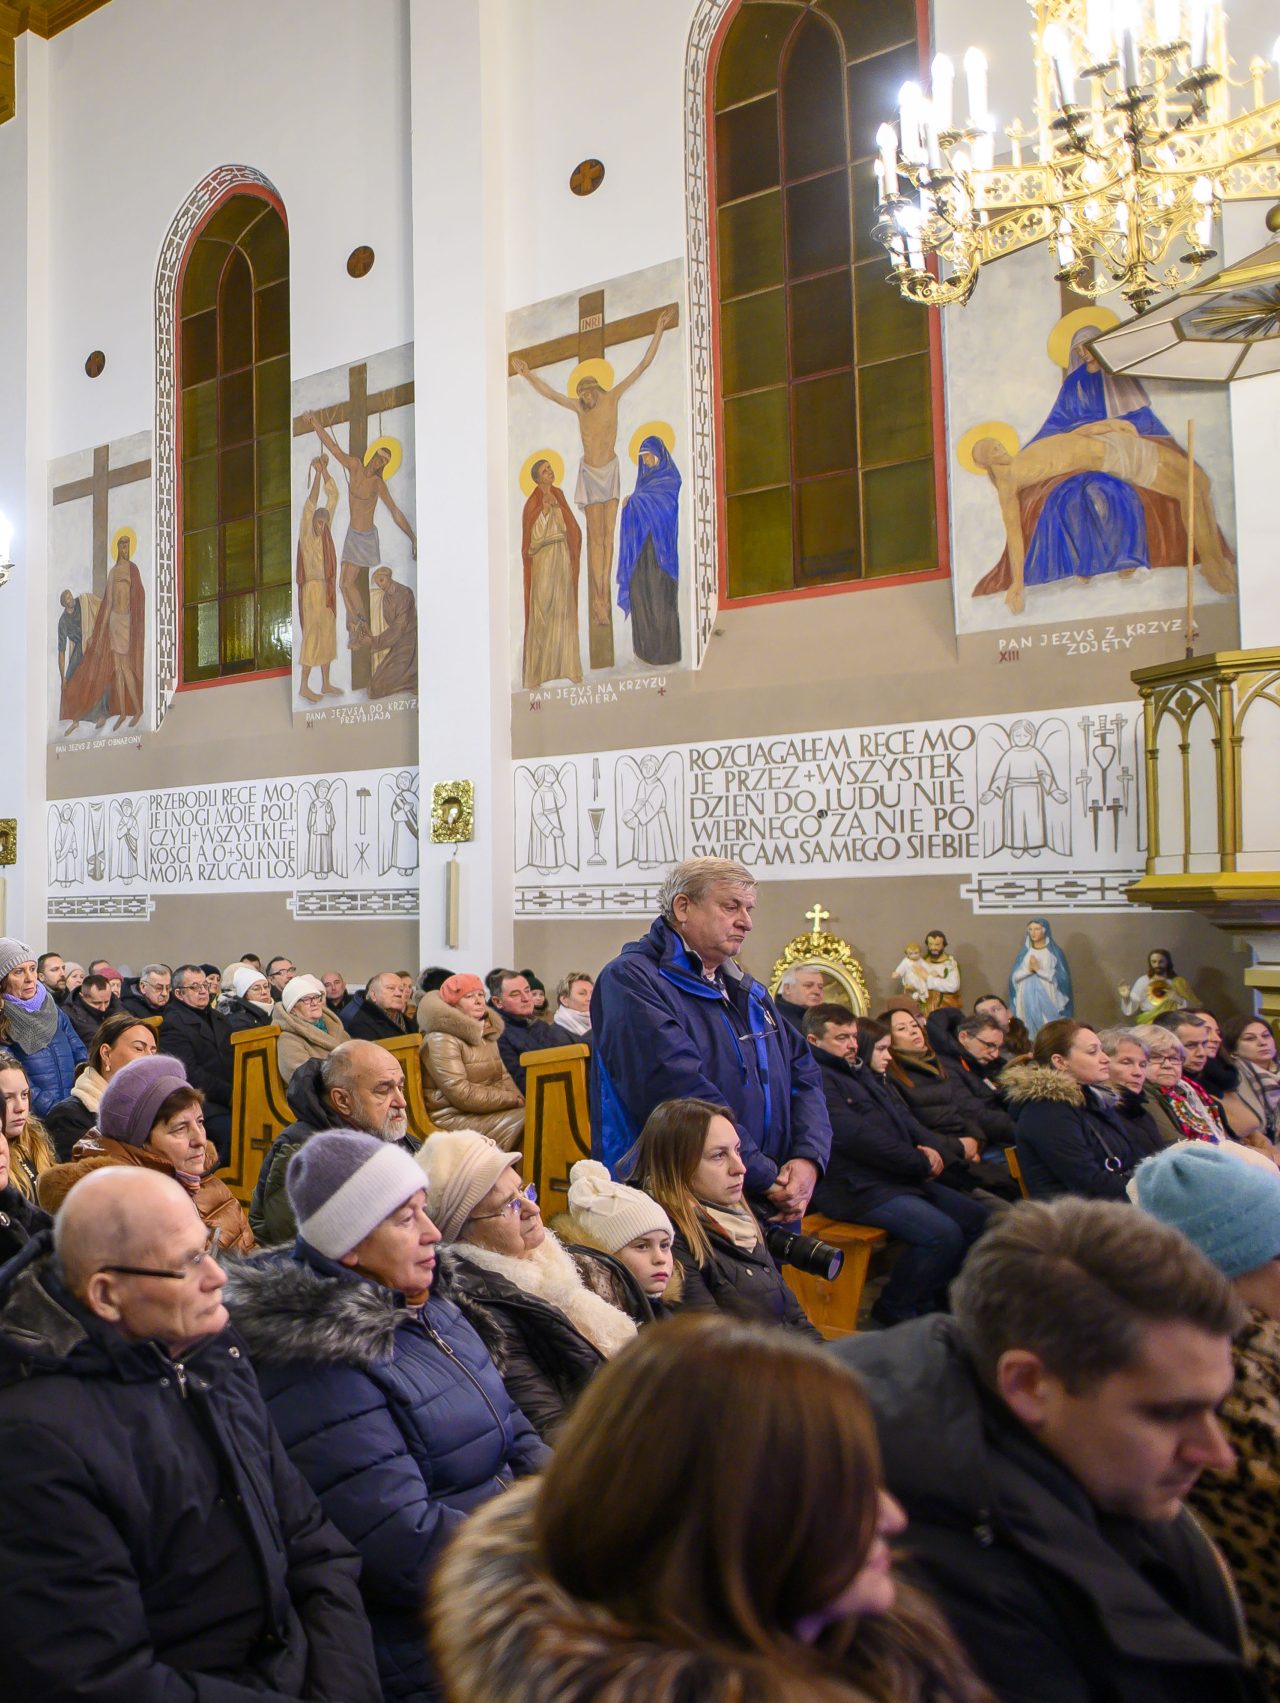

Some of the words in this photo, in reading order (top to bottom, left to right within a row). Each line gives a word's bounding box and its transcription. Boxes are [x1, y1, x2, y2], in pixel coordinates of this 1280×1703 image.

[998, 636, 1032, 650] PAN
[1104, 626, 1115, 639] Z
[1066, 637, 1133, 656] ZDJĘTY
[998, 650, 1019, 663] XIII
[529, 691, 551, 702] PAN
[597, 682, 613, 694] NA
[305, 711, 327, 721] PANA
[369, 703, 383, 714] DO
[388, 699, 417, 712] KRZYŻ
[529, 701, 541, 711] XII
[859, 729, 915, 760] RĘCE
[920, 724, 976, 753] MO
[690, 772, 714, 795] JE
[724, 765, 801, 793] PRZEZ
[774, 790, 816, 815] DO
[826, 783, 901, 812] LUDU
[913, 779, 965, 807] NIE
[149, 812, 160, 829] JE
[171, 808, 210, 827] NOGI
[215, 805, 255, 824] MOJE
[691, 814, 822, 842] WIERNEGO
[830, 811, 867, 837] ZA
[875, 808, 924, 835] NIE
[933, 805, 975, 832] PO
[196, 845, 208, 863] A
[799, 836, 901, 863] SAMEGO
[906, 832, 979, 859] SIEBIE
[198, 862, 261, 881] RZUCALI
